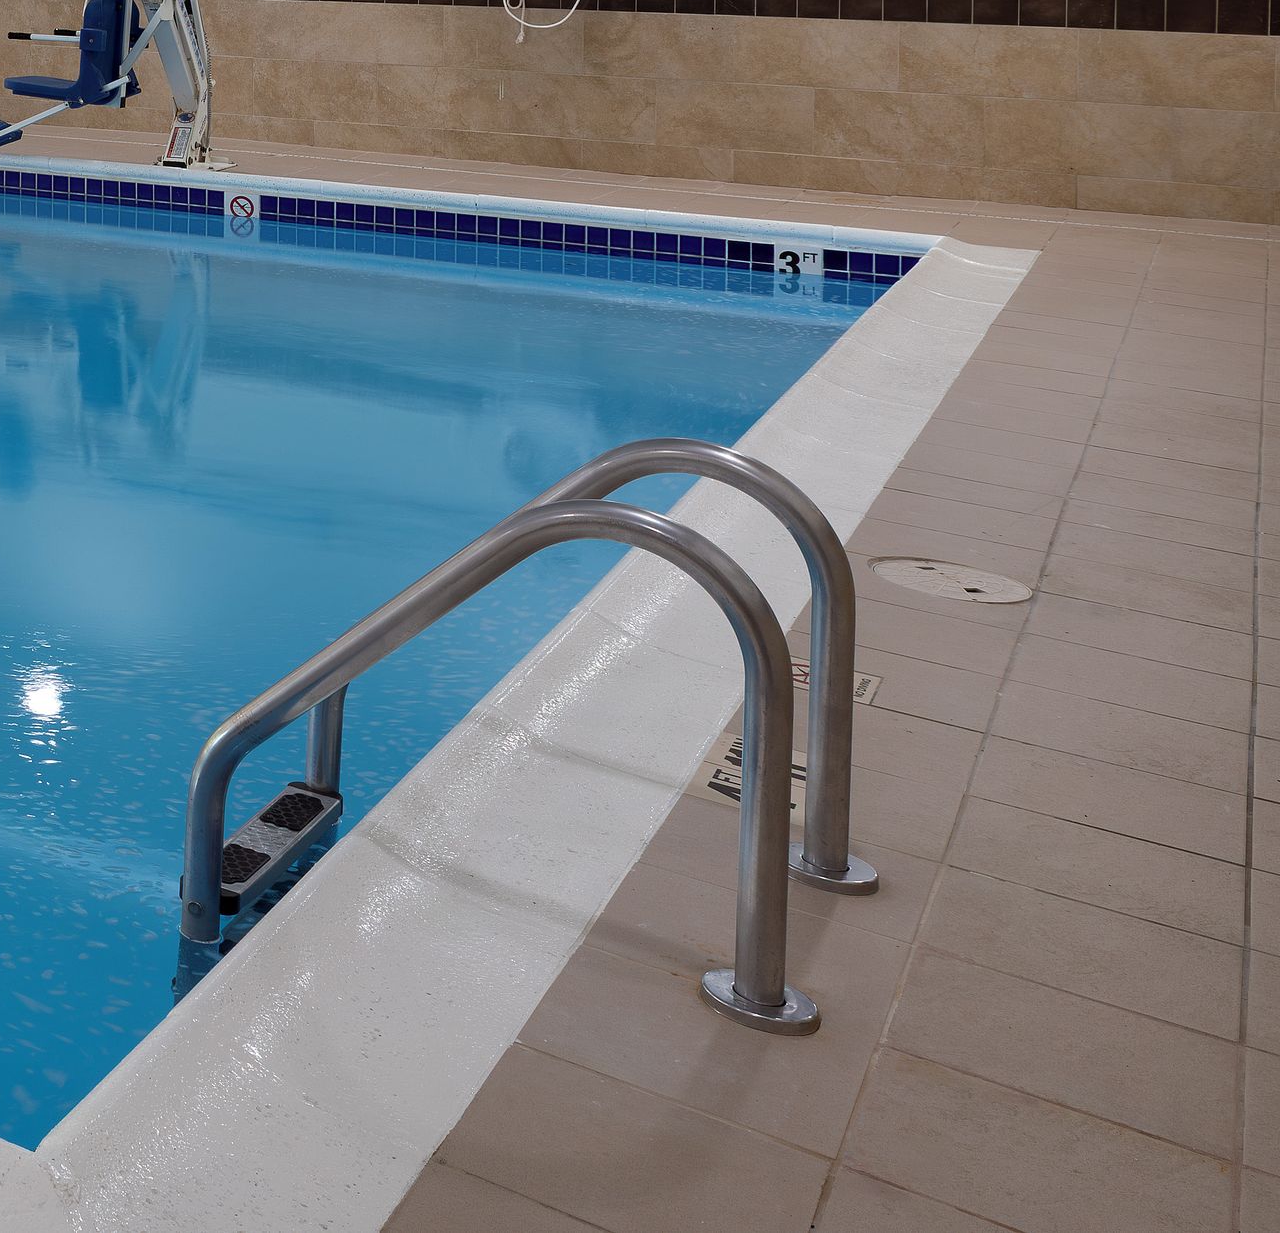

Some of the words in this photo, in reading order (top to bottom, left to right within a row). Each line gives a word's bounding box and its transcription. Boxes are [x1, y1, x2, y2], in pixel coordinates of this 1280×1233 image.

[779, 251, 801, 274] 3
[803, 252, 818, 263] FT
[856, 678, 872, 692] DIVING
